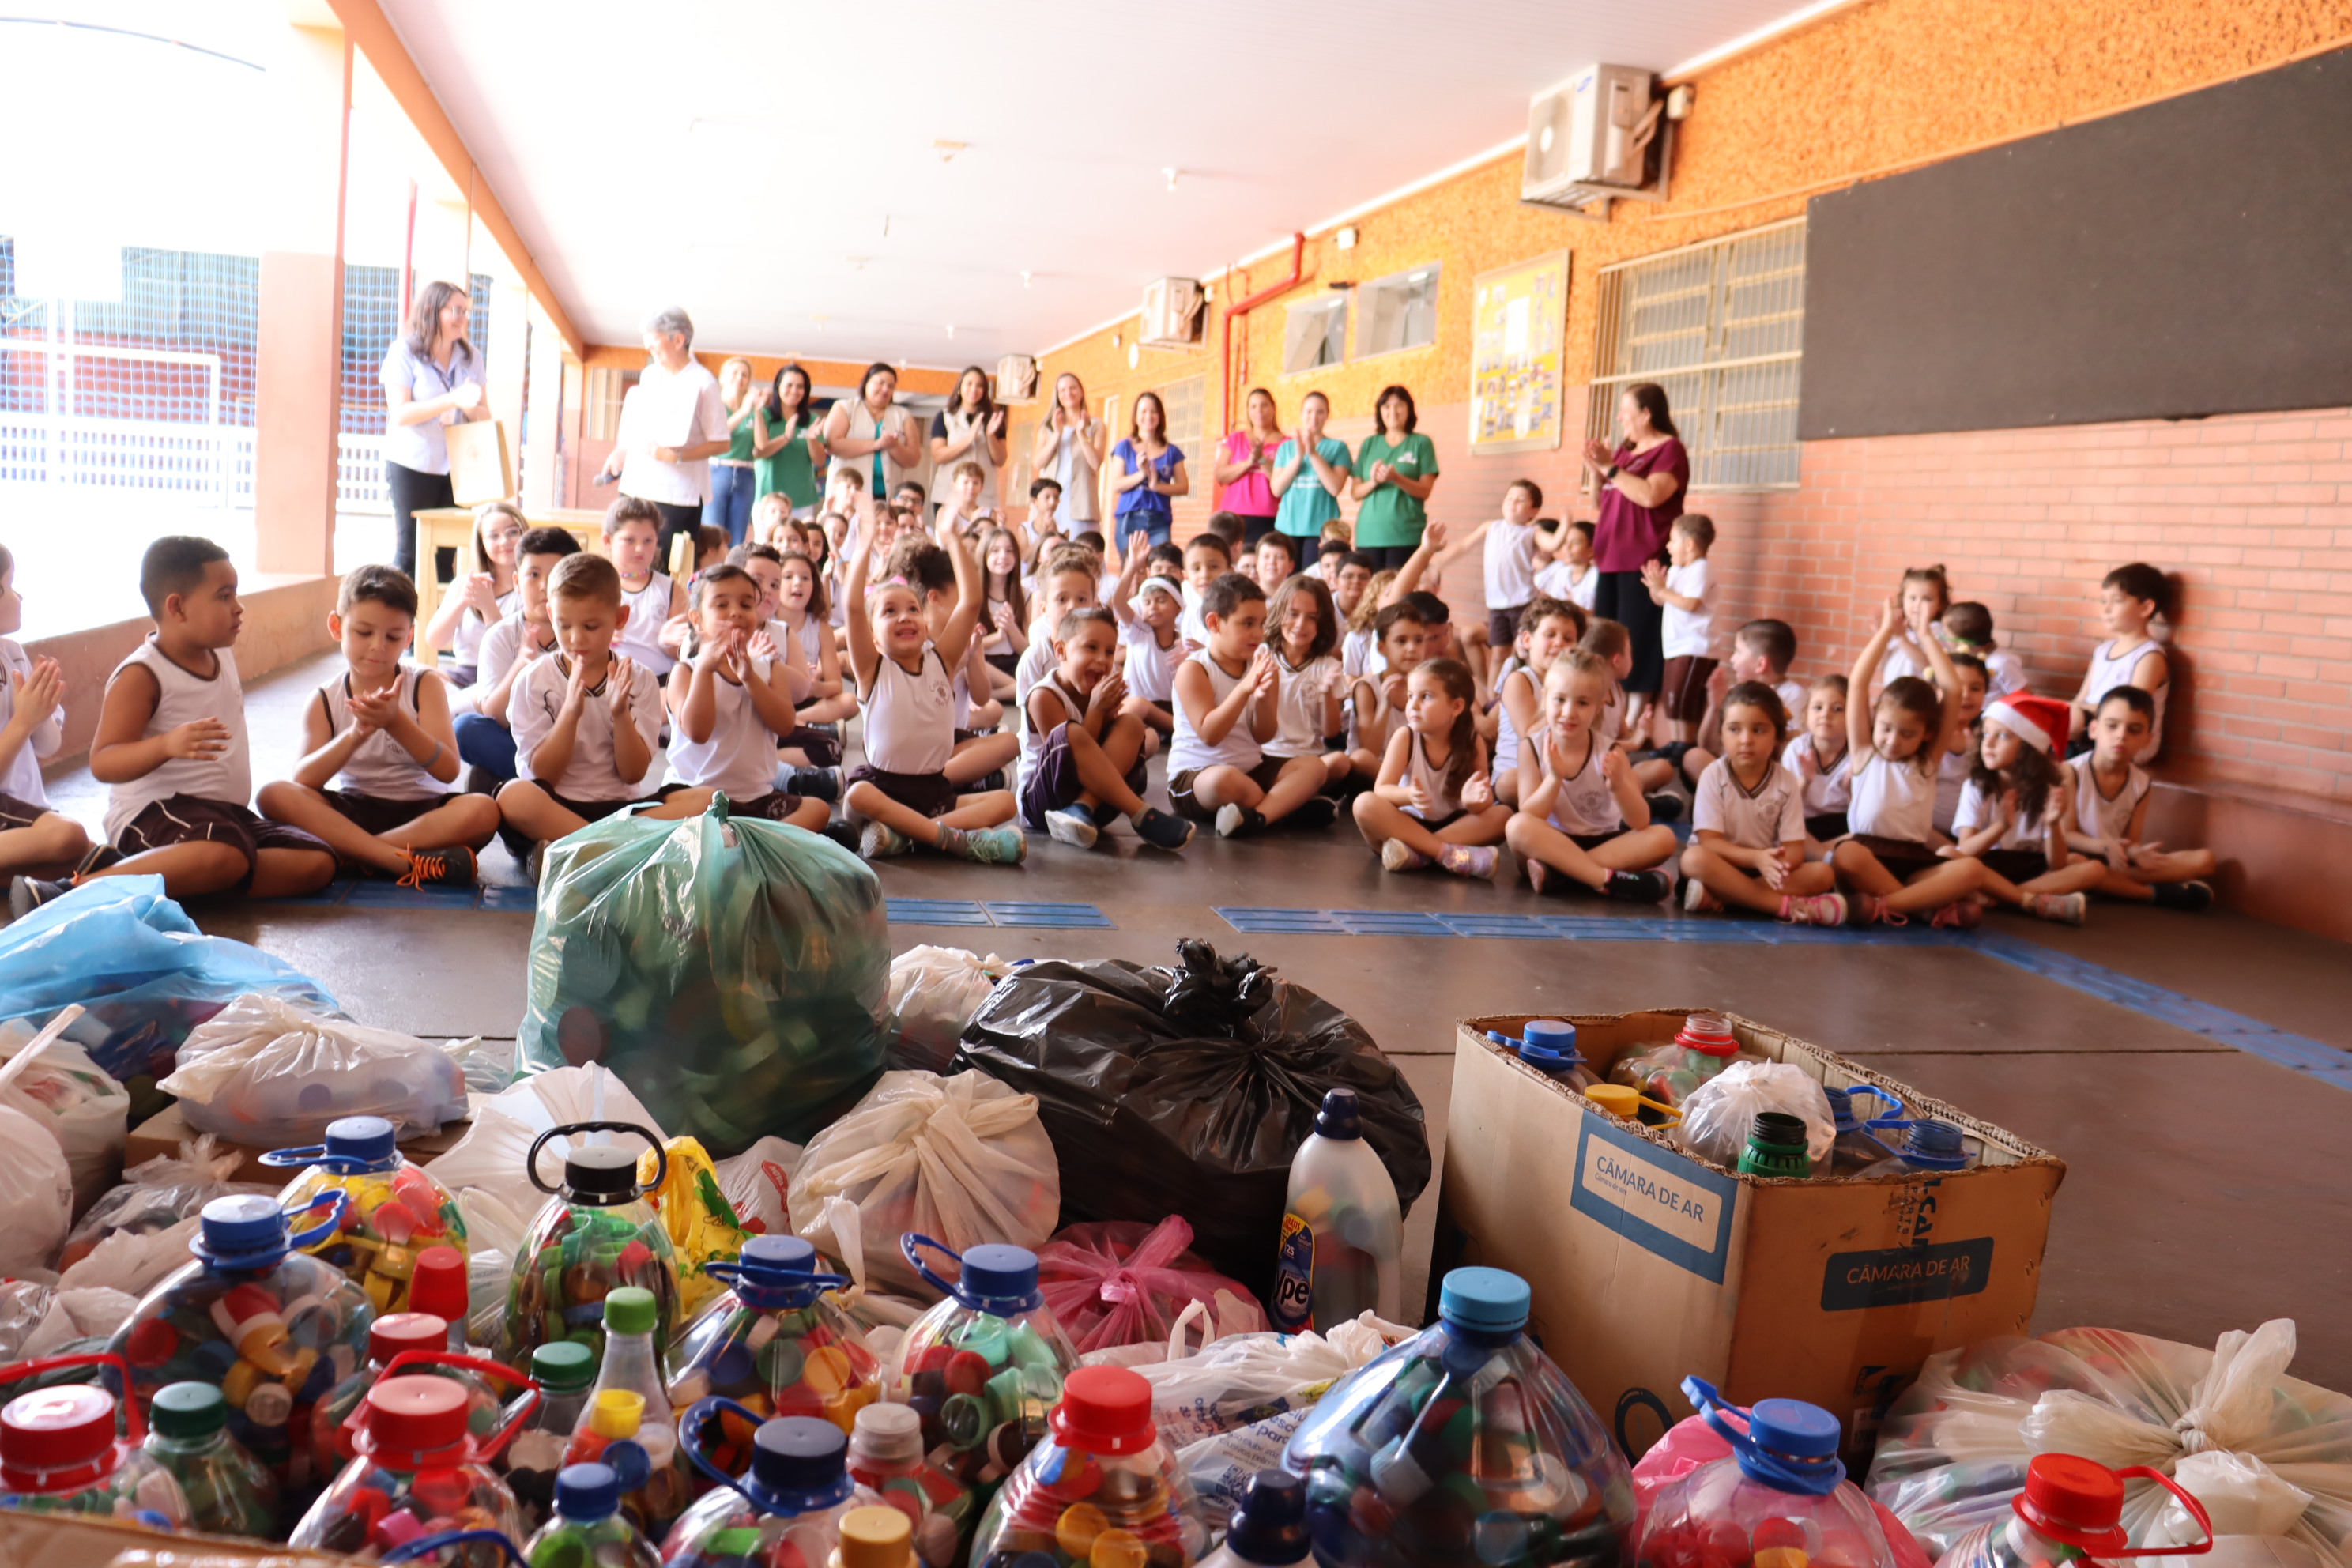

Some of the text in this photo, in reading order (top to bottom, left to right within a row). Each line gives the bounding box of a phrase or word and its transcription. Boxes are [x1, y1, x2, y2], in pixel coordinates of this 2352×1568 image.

[1597, 1156, 1704, 1222] CÂMARA DE AR
[1847, 1255, 1970, 1284] CÂMARA DE AR
